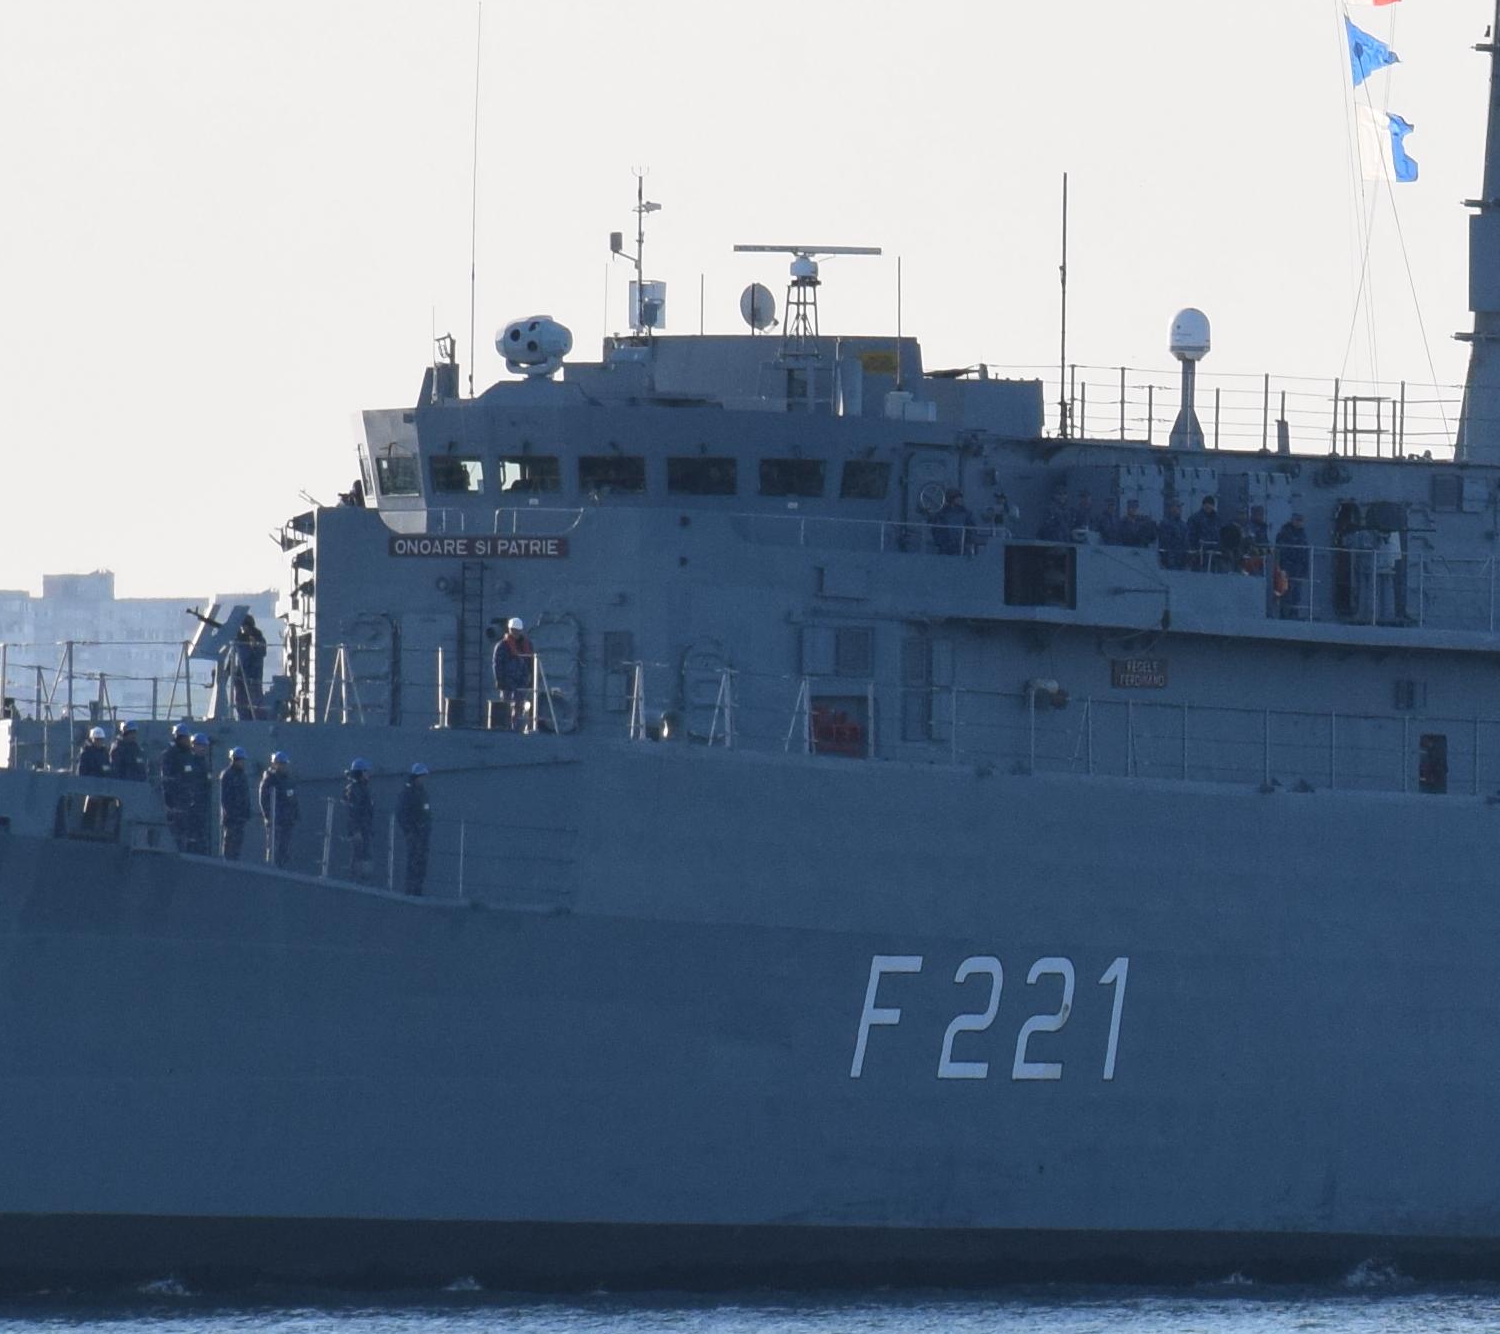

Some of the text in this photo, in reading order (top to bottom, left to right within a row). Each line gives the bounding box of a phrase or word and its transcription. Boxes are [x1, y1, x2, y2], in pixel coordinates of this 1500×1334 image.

[395, 539, 559, 555] ONOARE SI PATRIE
[850, 955, 1129, 1079] F 221
